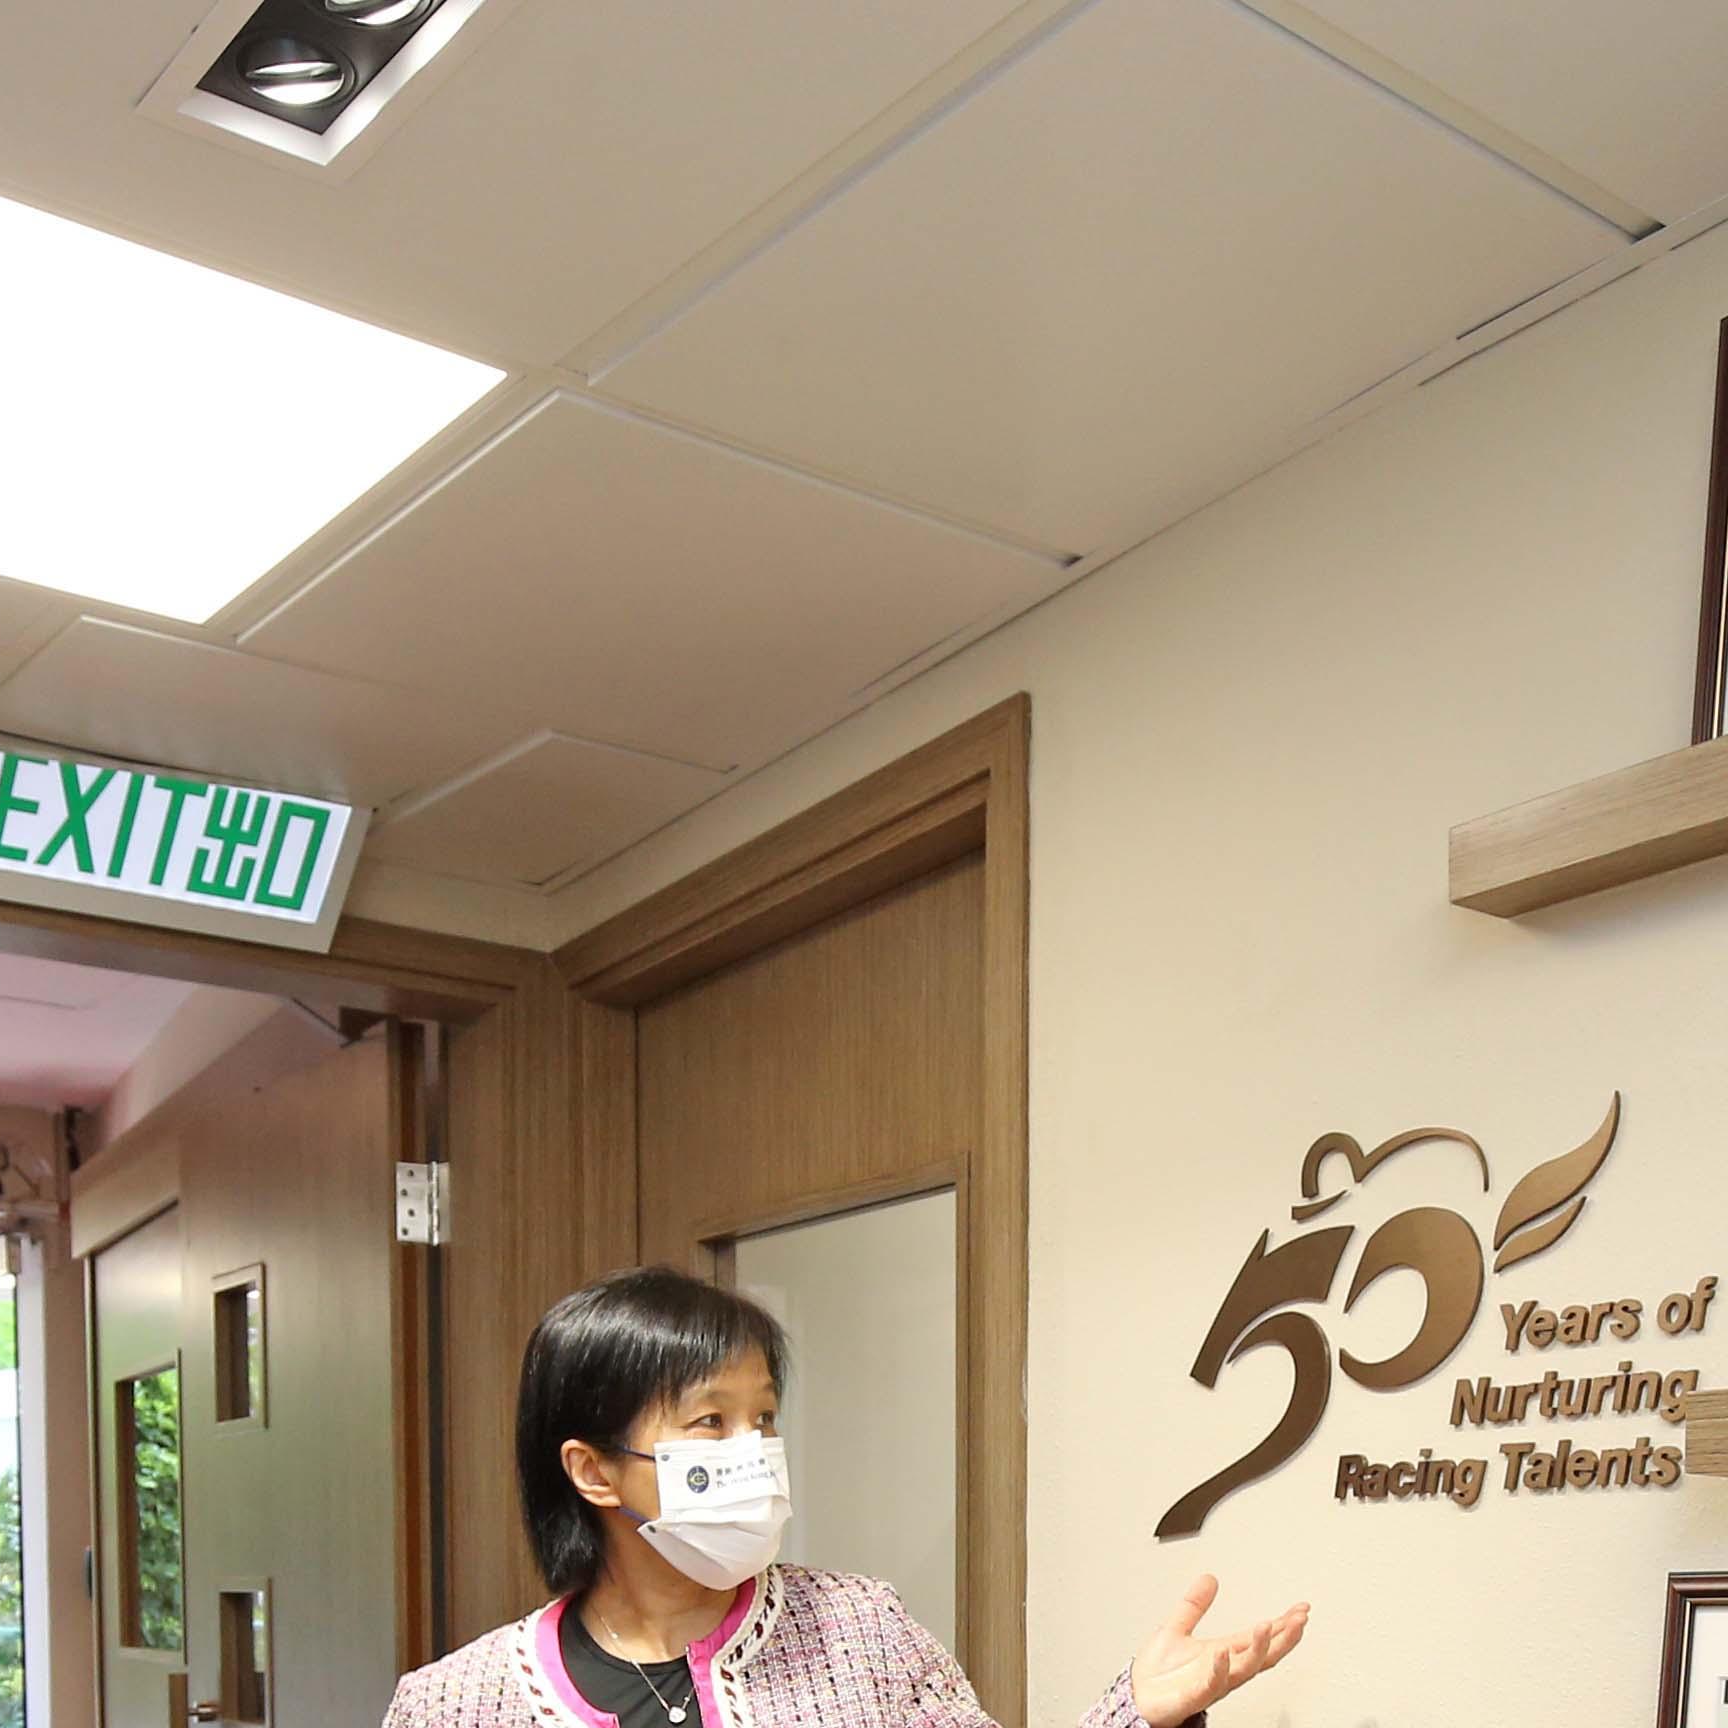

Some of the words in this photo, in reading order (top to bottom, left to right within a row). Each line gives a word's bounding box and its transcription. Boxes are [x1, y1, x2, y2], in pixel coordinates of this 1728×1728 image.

[187, 786, 331, 911] 出口
[1499, 1299, 1642, 1352] Years
[1656, 1276, 1719, 1333] of
[1449, 1361, 1699, 1427] Nurturing
[1334, 1449, 1488, 1508] Racing
[1498, 1437, 1683, 1491] Talents
